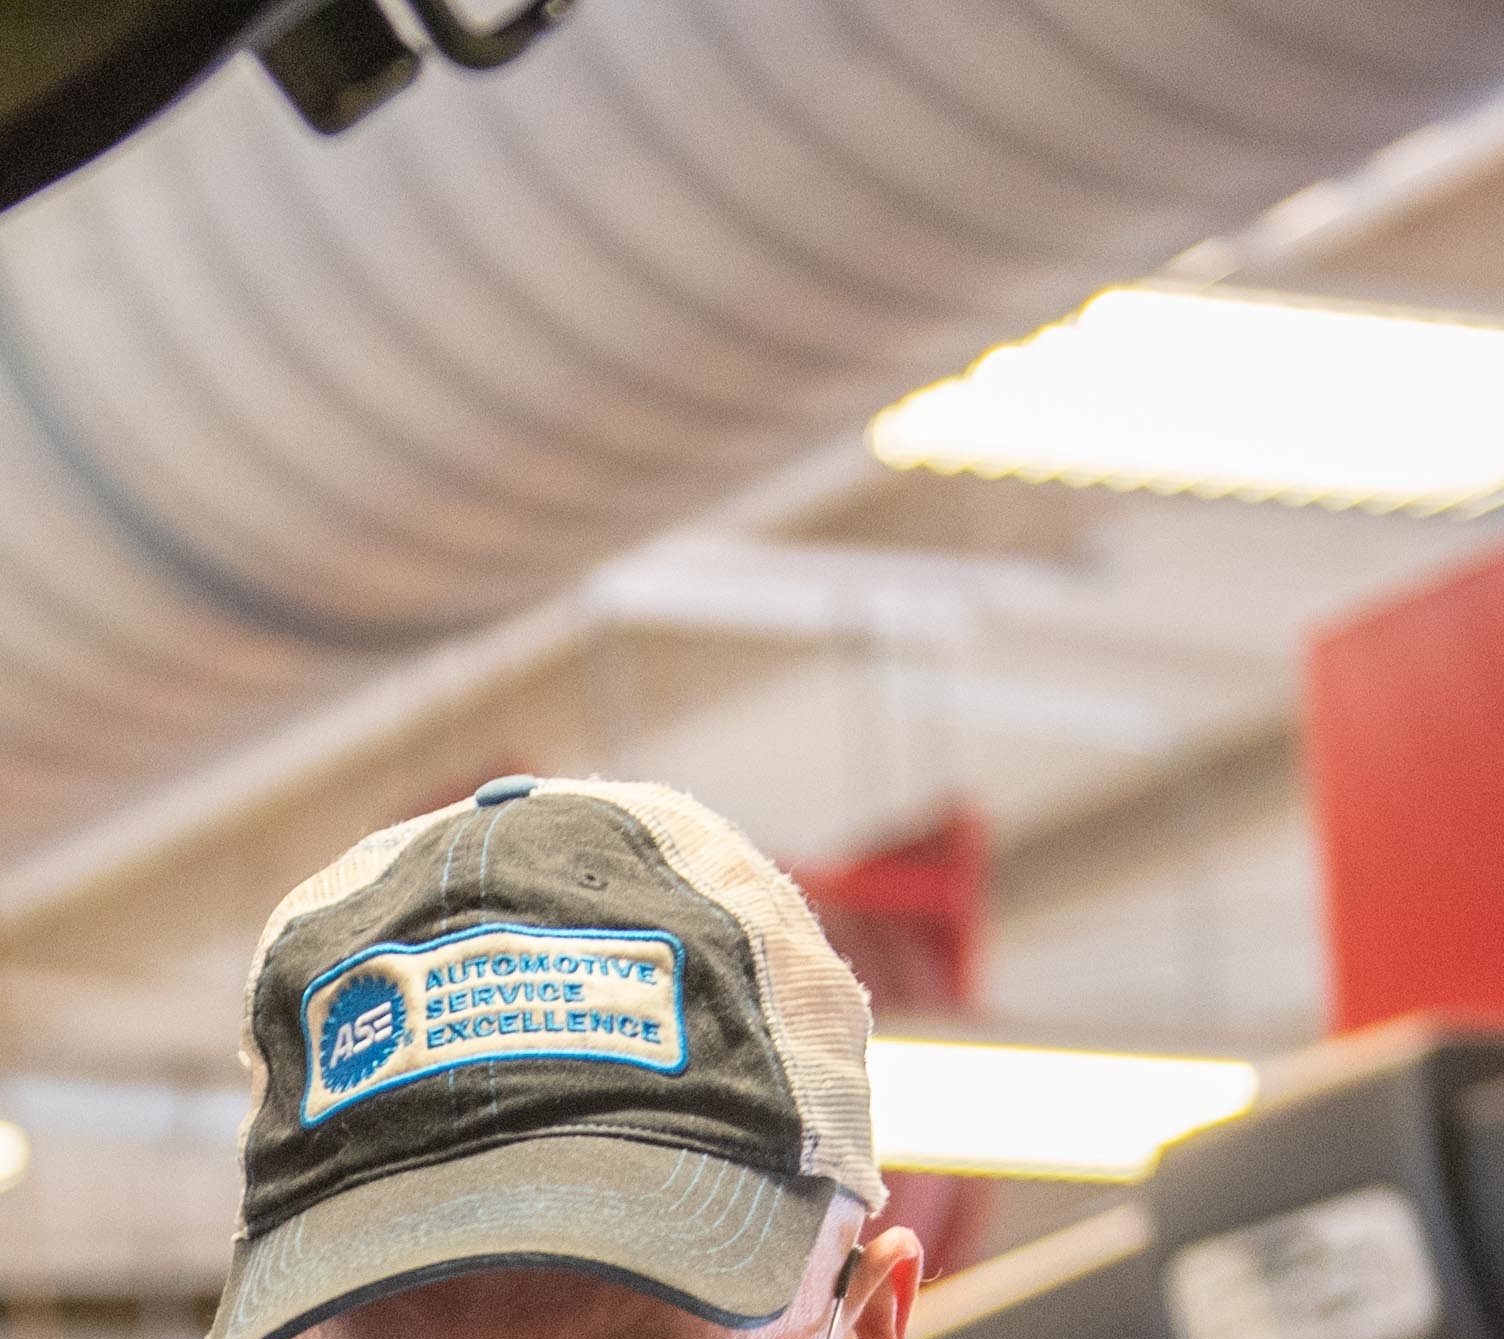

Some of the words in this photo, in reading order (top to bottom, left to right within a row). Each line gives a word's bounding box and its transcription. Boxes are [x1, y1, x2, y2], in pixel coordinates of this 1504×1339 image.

[426, 954, 658, 991] AUTOMOTIVE
[425, 981, 585, 1019] SERVICE
[331, 1001, 393, 1068] ASE
[426, 1009, 661, 1049] EXCELLENCE
